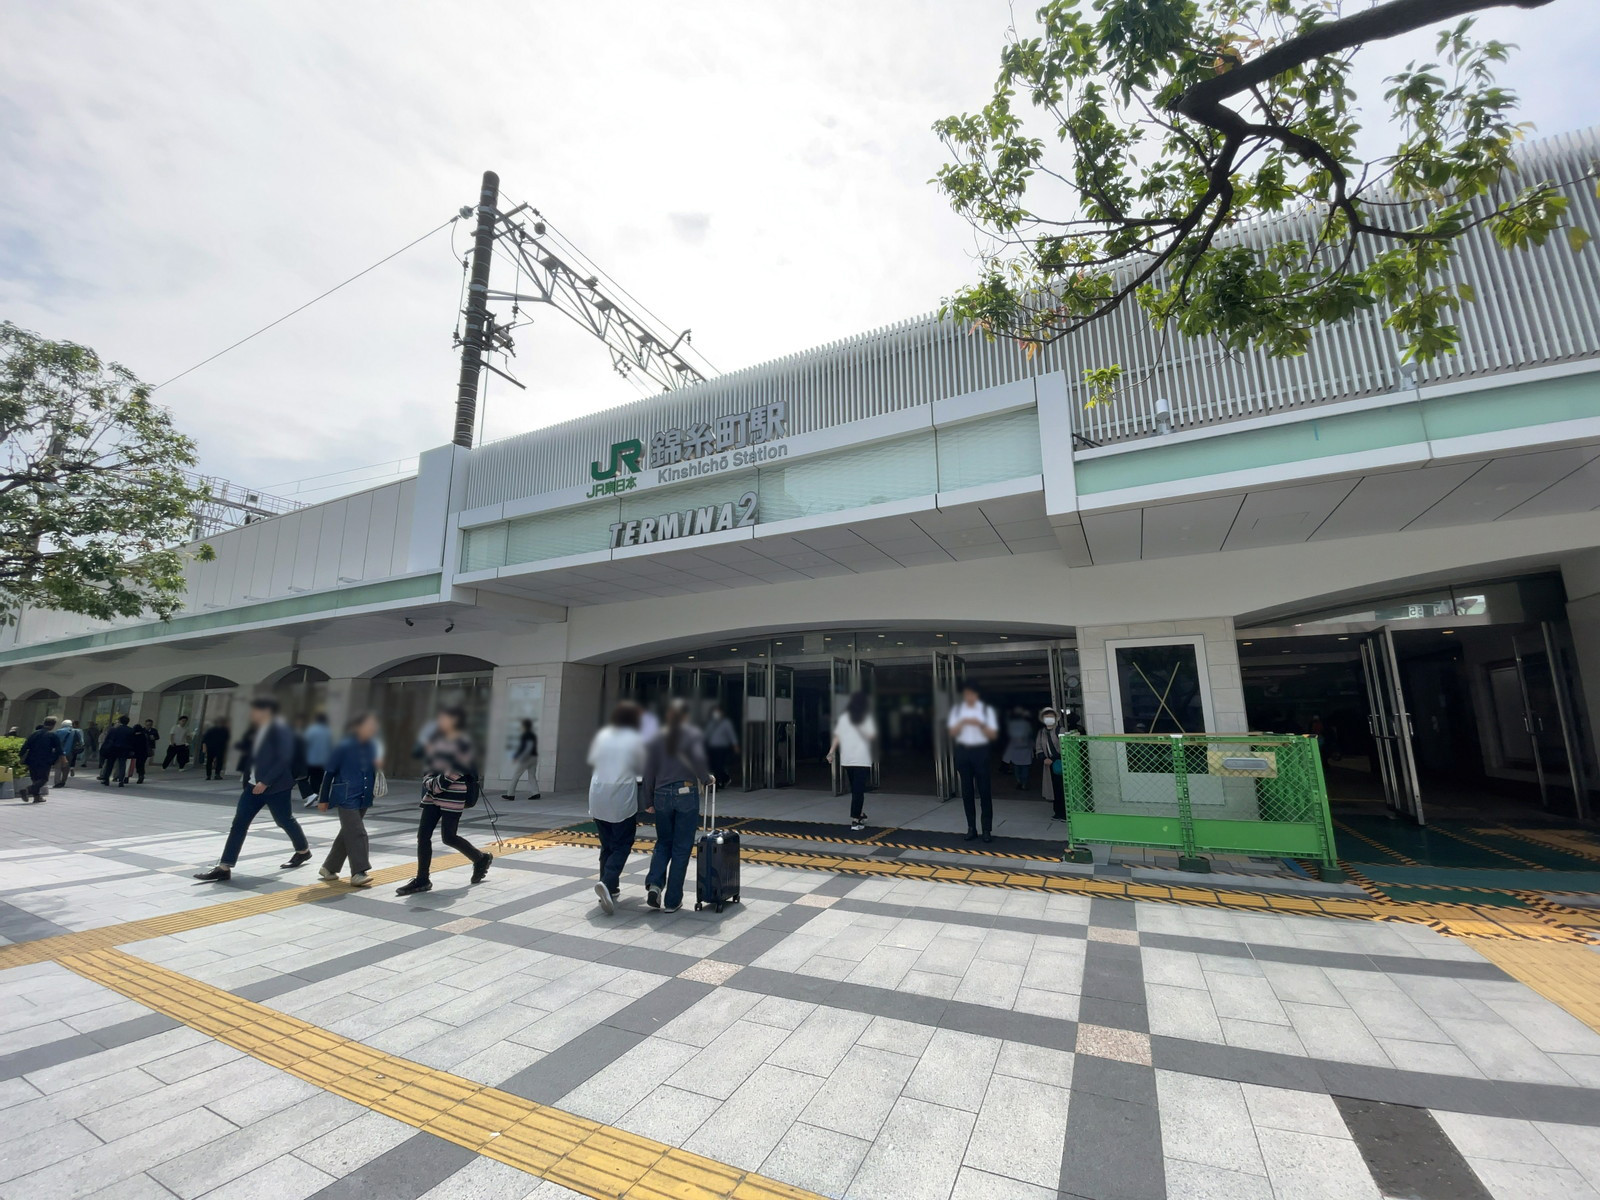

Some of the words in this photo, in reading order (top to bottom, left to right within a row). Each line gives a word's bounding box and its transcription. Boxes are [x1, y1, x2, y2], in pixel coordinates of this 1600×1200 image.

[651, 400, 786, 468] 錦糸町駅
[591, 438, 643, 481] JR
[658, 457, 728, 484] Kinshichō
[733, 444, 788, 467] Station
[586, 476, 637, 499] JR東日本
